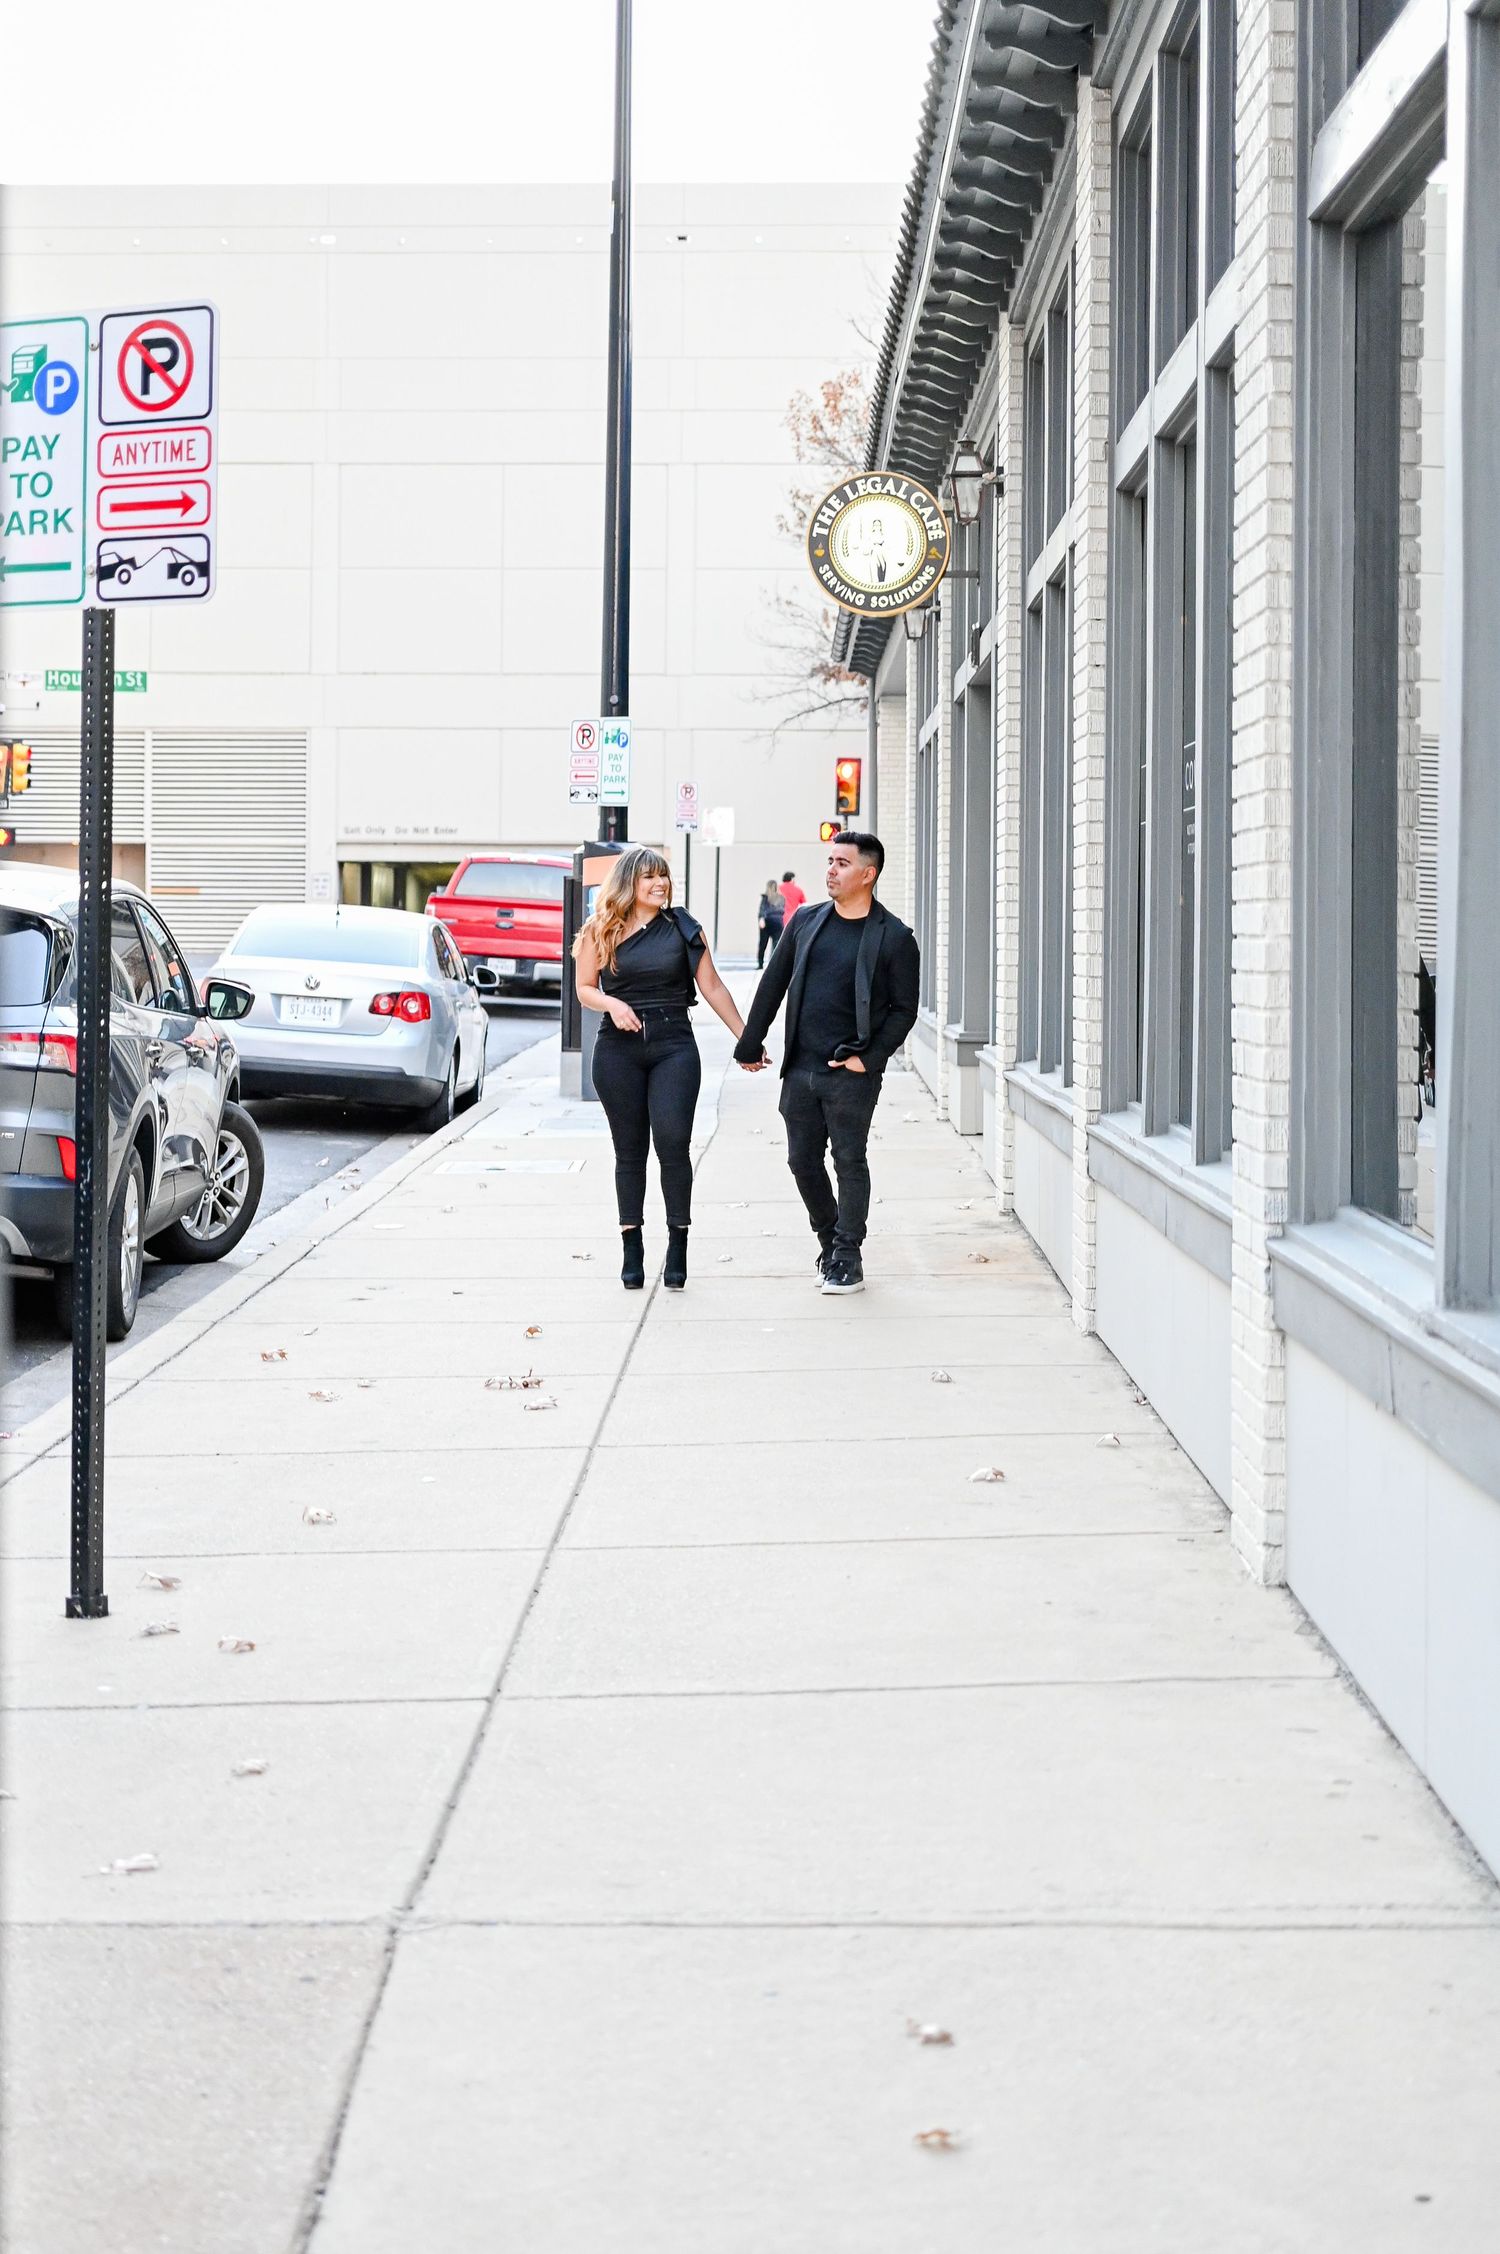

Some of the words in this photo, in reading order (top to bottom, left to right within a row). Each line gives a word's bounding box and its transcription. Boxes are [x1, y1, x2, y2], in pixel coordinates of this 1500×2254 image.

[2, 433, 61, 463] PAY
[112, 438, 197, 466] ANYTIME
[9, 470, 54, 499] TO
[812, 494, 845, 537] THE
[843, 476, 909, 501] LEGAL
[0, 507, 74, 537] ARK
[818, 563, 866, 606] SERVING
[870, 564, 936, 608] SOLUTIONS
[47, 670, 123, 687] Houn
[125, 671, 144, 687] St
[608, 753, 624, 761] PAY
[610, 764, 622, 773] TO
[603, 775, 627, 784] PARK
[1185, 760, 1196, 790] CO
